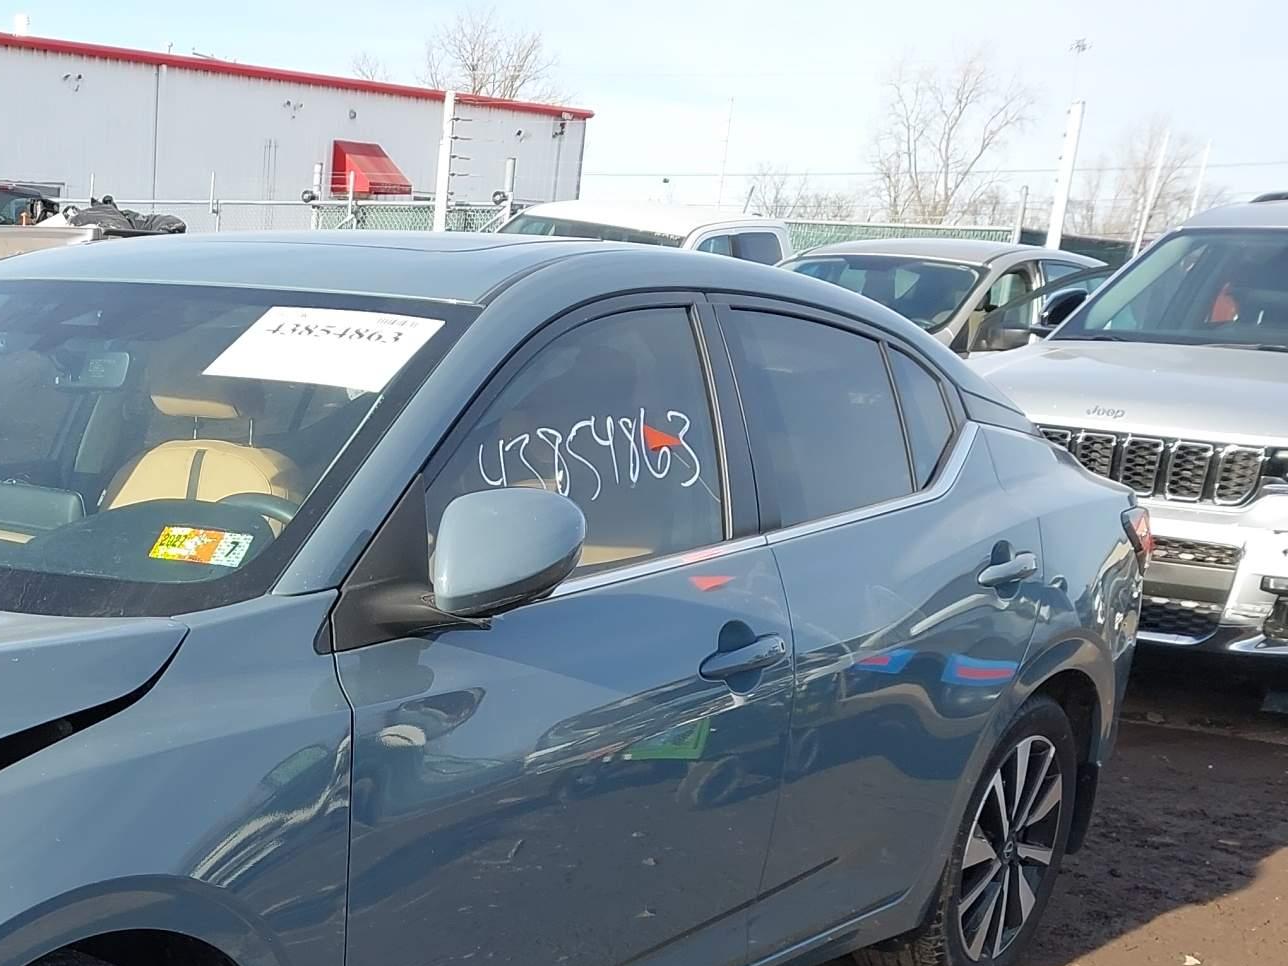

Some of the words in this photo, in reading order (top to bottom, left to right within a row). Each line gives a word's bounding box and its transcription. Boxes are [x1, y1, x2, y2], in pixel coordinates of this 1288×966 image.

[265, 322, 404, 344] 43854863
[1085, 405, 1126, 420] Jeep
[478, 407, 701, 501] 43854863
[224, 540, 240, 558] 7
